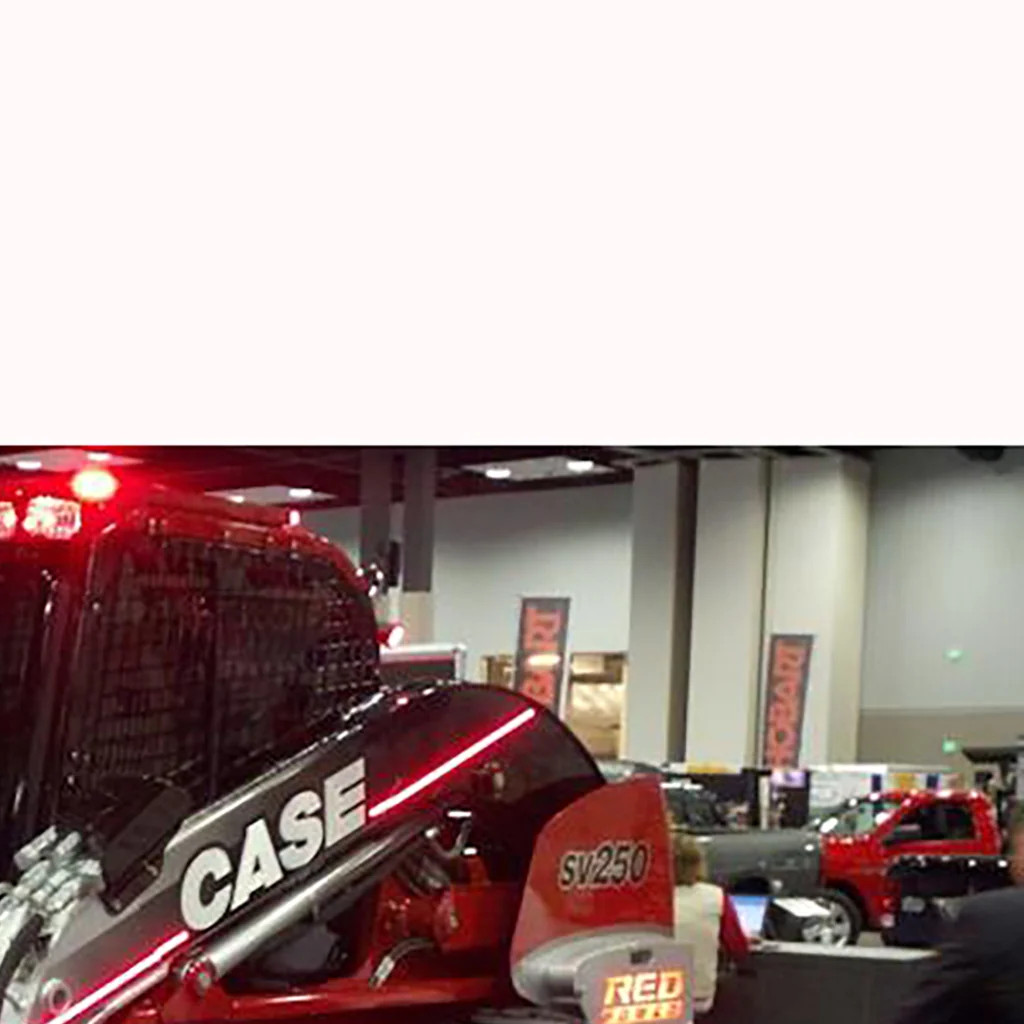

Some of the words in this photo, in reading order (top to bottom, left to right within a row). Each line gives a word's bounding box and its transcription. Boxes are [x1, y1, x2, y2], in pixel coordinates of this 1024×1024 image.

[180, 757, 366, 931] CASE
[558, 841, 651, 890] SV250
[602, 969, 688, 1006] RED
